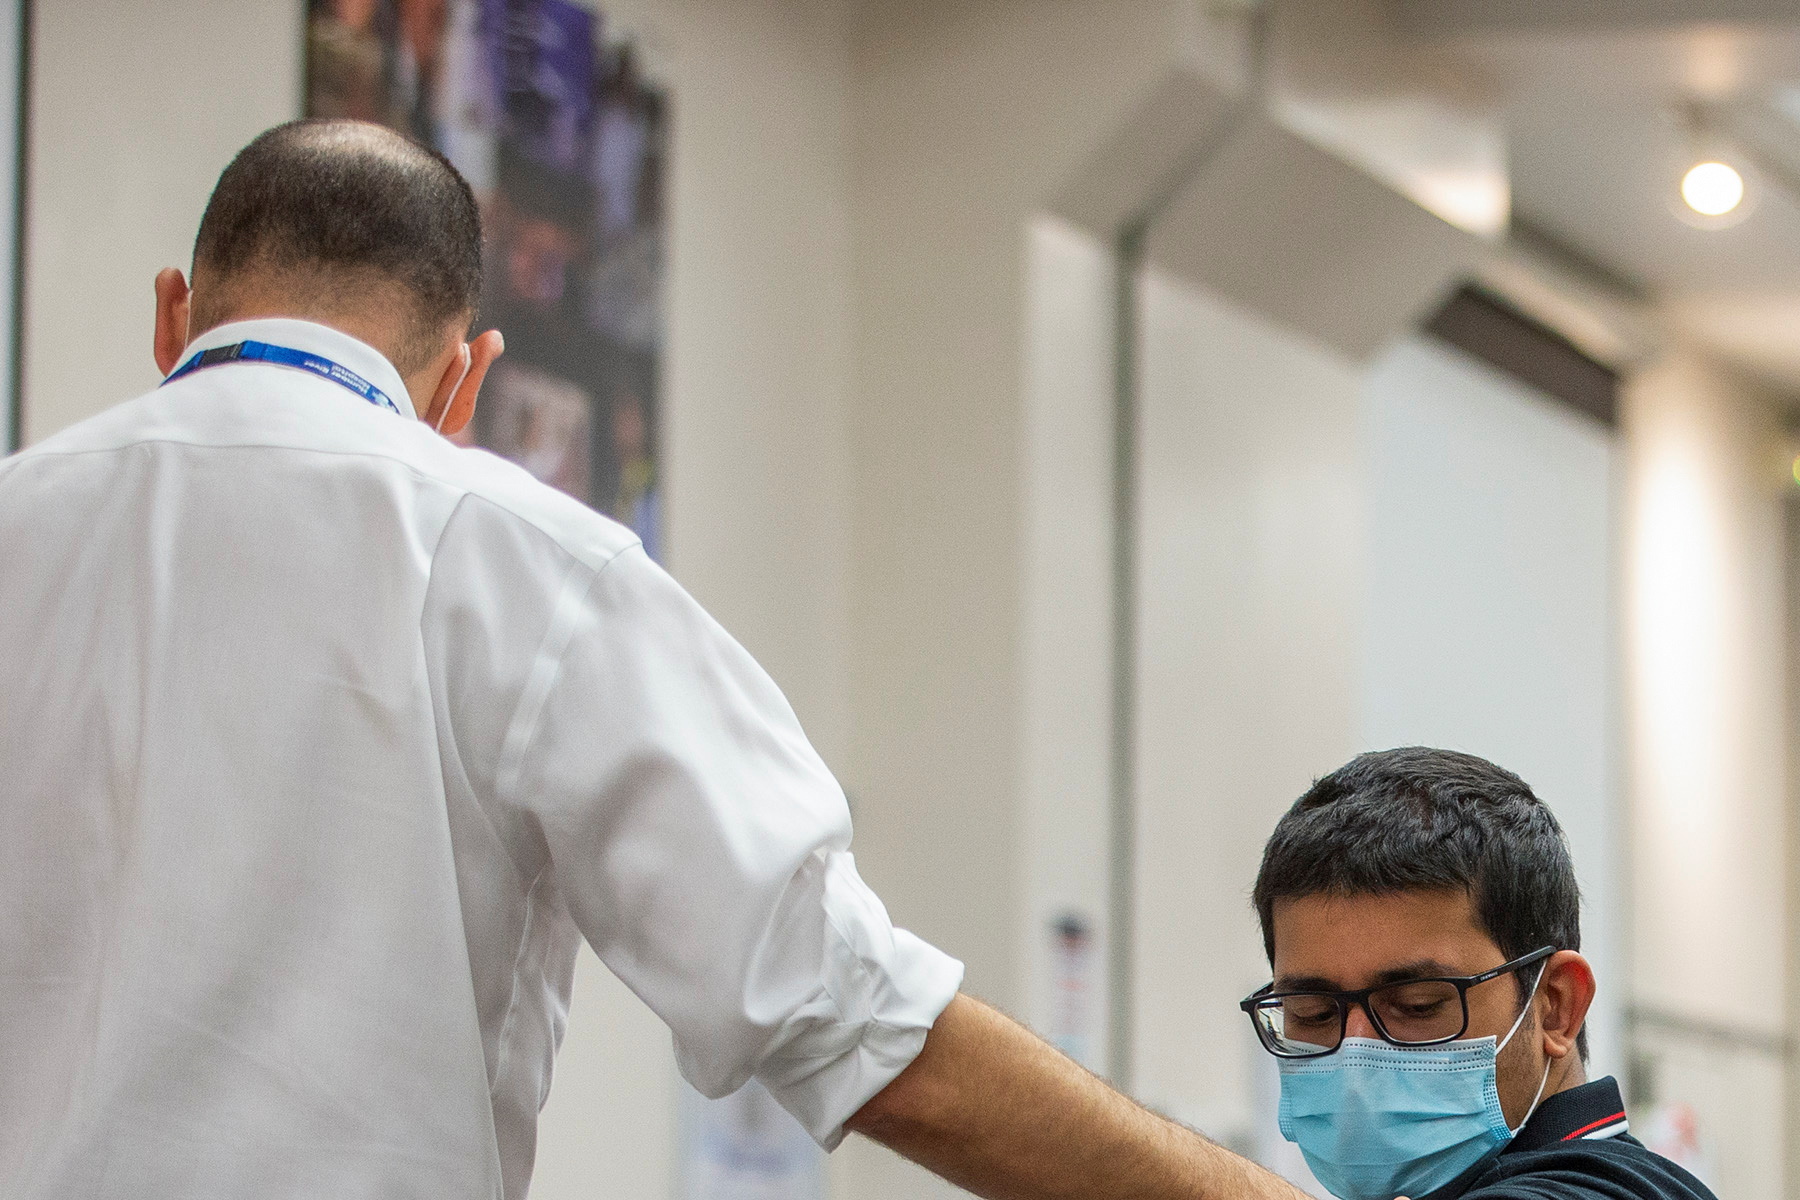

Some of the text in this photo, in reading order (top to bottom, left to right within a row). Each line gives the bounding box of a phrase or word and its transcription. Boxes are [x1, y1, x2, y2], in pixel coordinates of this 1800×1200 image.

[304, 361, 369, 395] Humber River
[331, 365, 370, 390] Hospital
